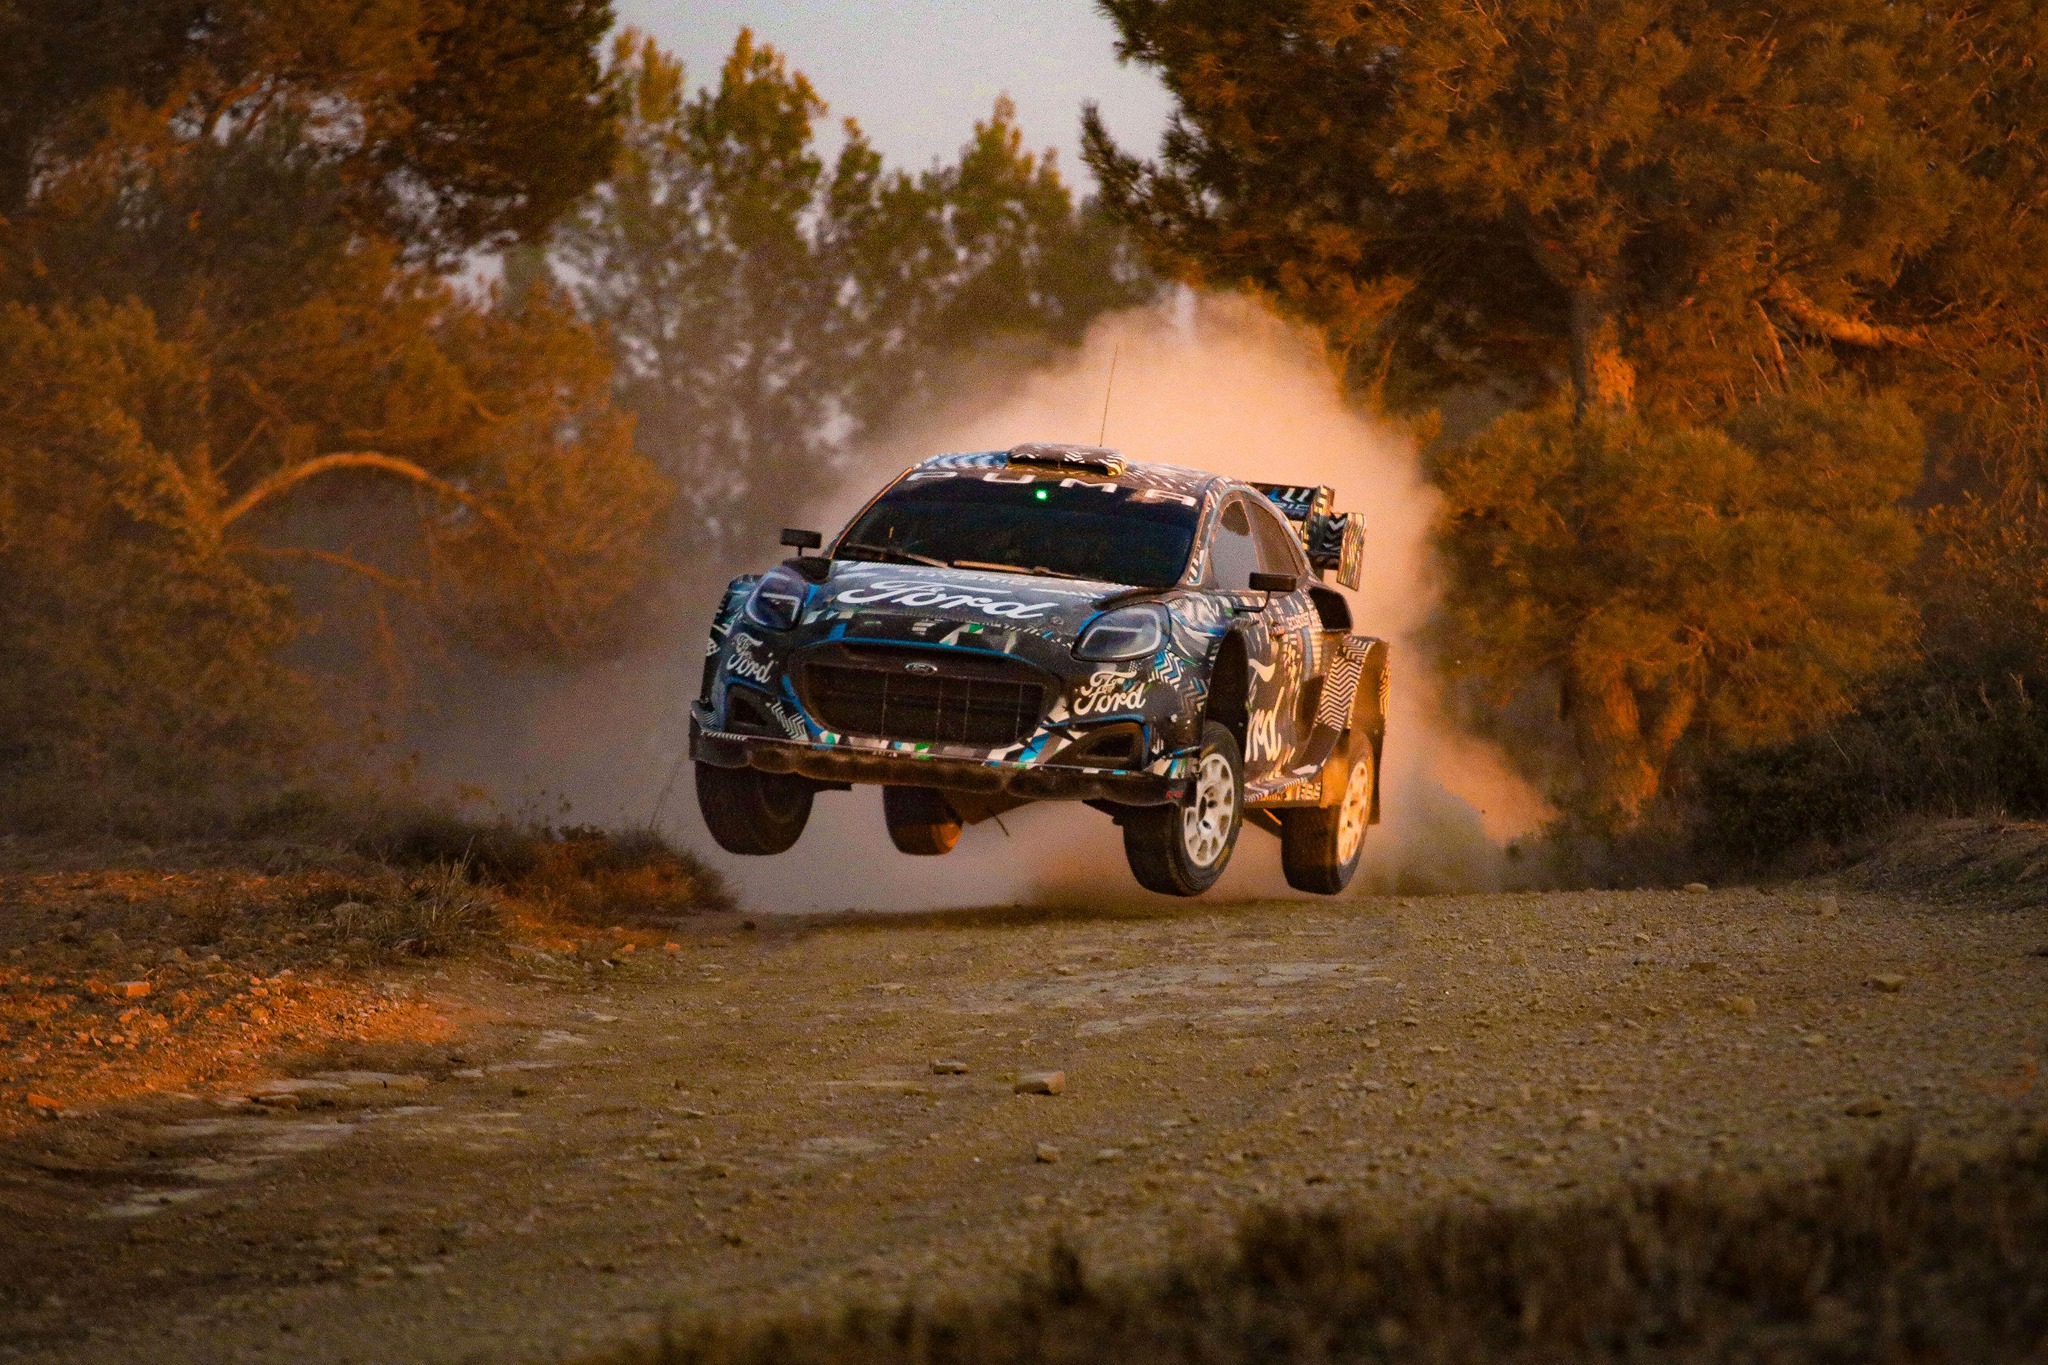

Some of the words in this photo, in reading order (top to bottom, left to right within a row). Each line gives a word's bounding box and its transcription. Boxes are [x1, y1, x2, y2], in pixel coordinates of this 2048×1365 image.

[837, 579, 1060, 619] Ford
[727, 632, 775, 683] Ford
[1074, 670, 1147, 715] Ford
